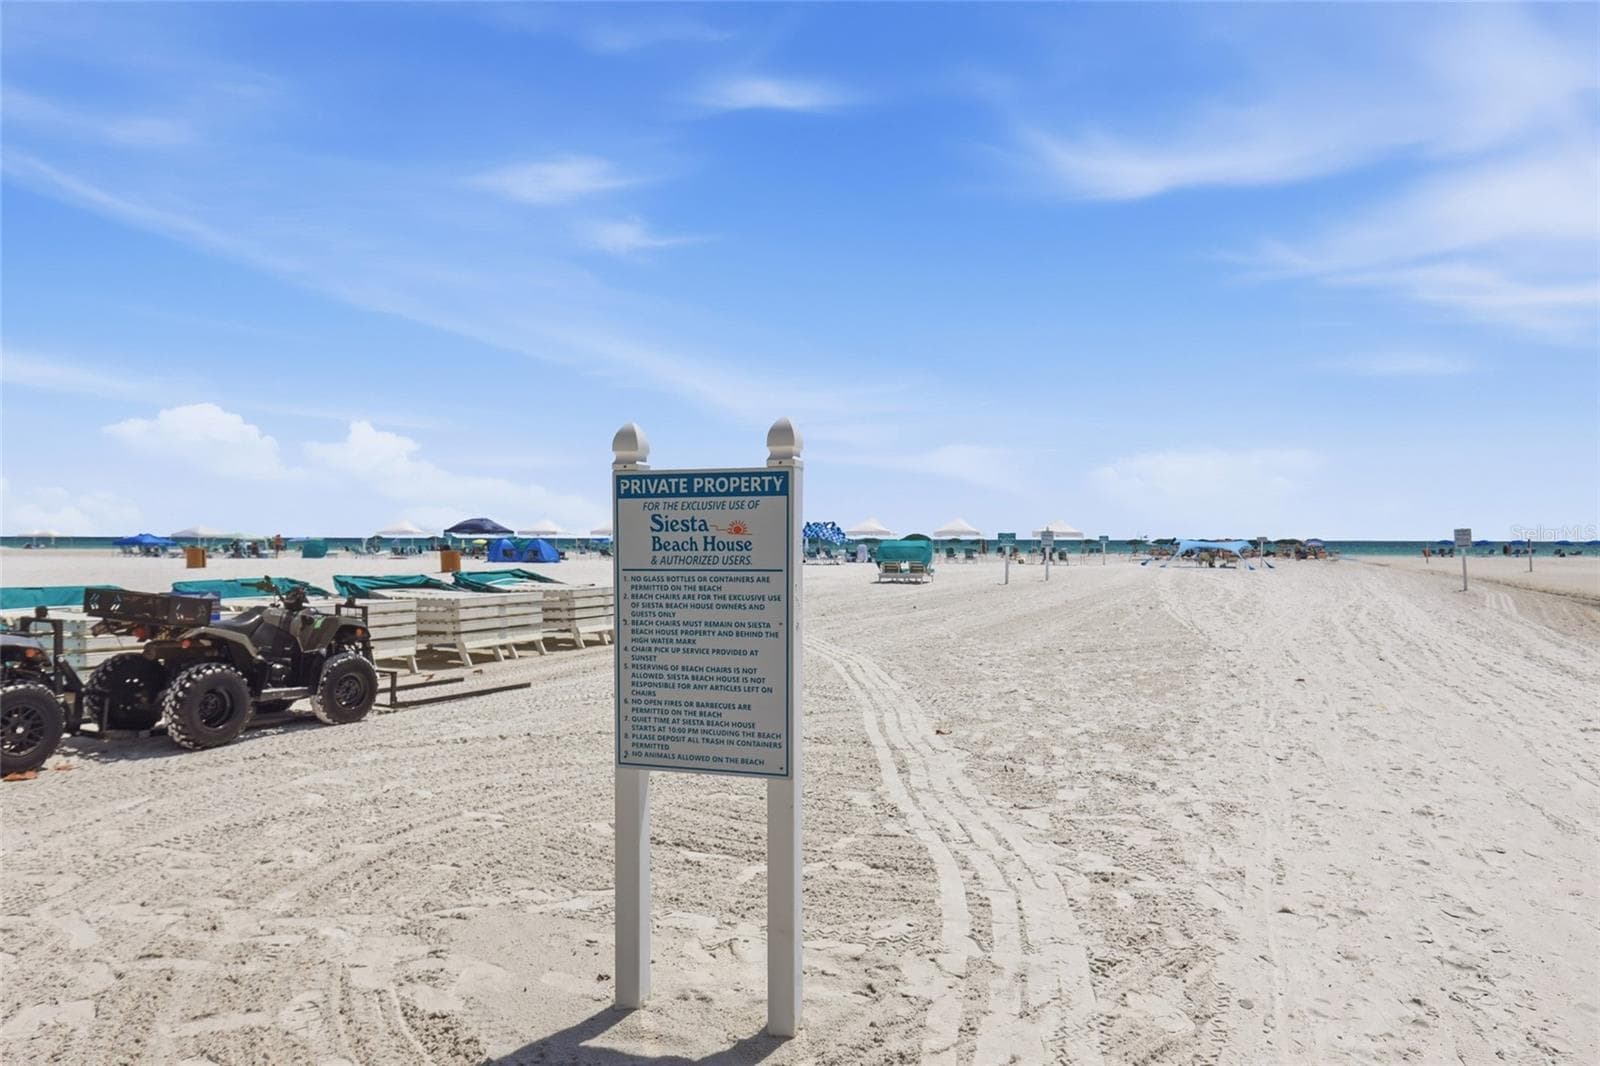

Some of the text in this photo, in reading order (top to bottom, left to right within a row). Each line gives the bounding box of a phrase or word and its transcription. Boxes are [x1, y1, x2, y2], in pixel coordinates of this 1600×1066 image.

[620, 476, 783, 494] PRIVATE PROPERTY
[643, 500, 760, 511] FOR THE EXCLUSIVE USE OF
[650, 514, 709, 532] Siesta
[652, 536, 752, 552] Beach House
[651, 556, 752, 565] & AUTHORIZED USERS.
[701, 728, 740, 737] INCLUDING
[736, 739, 782, 749] CONTAINERS
[677, 754, 710, 762] ALLOWED
